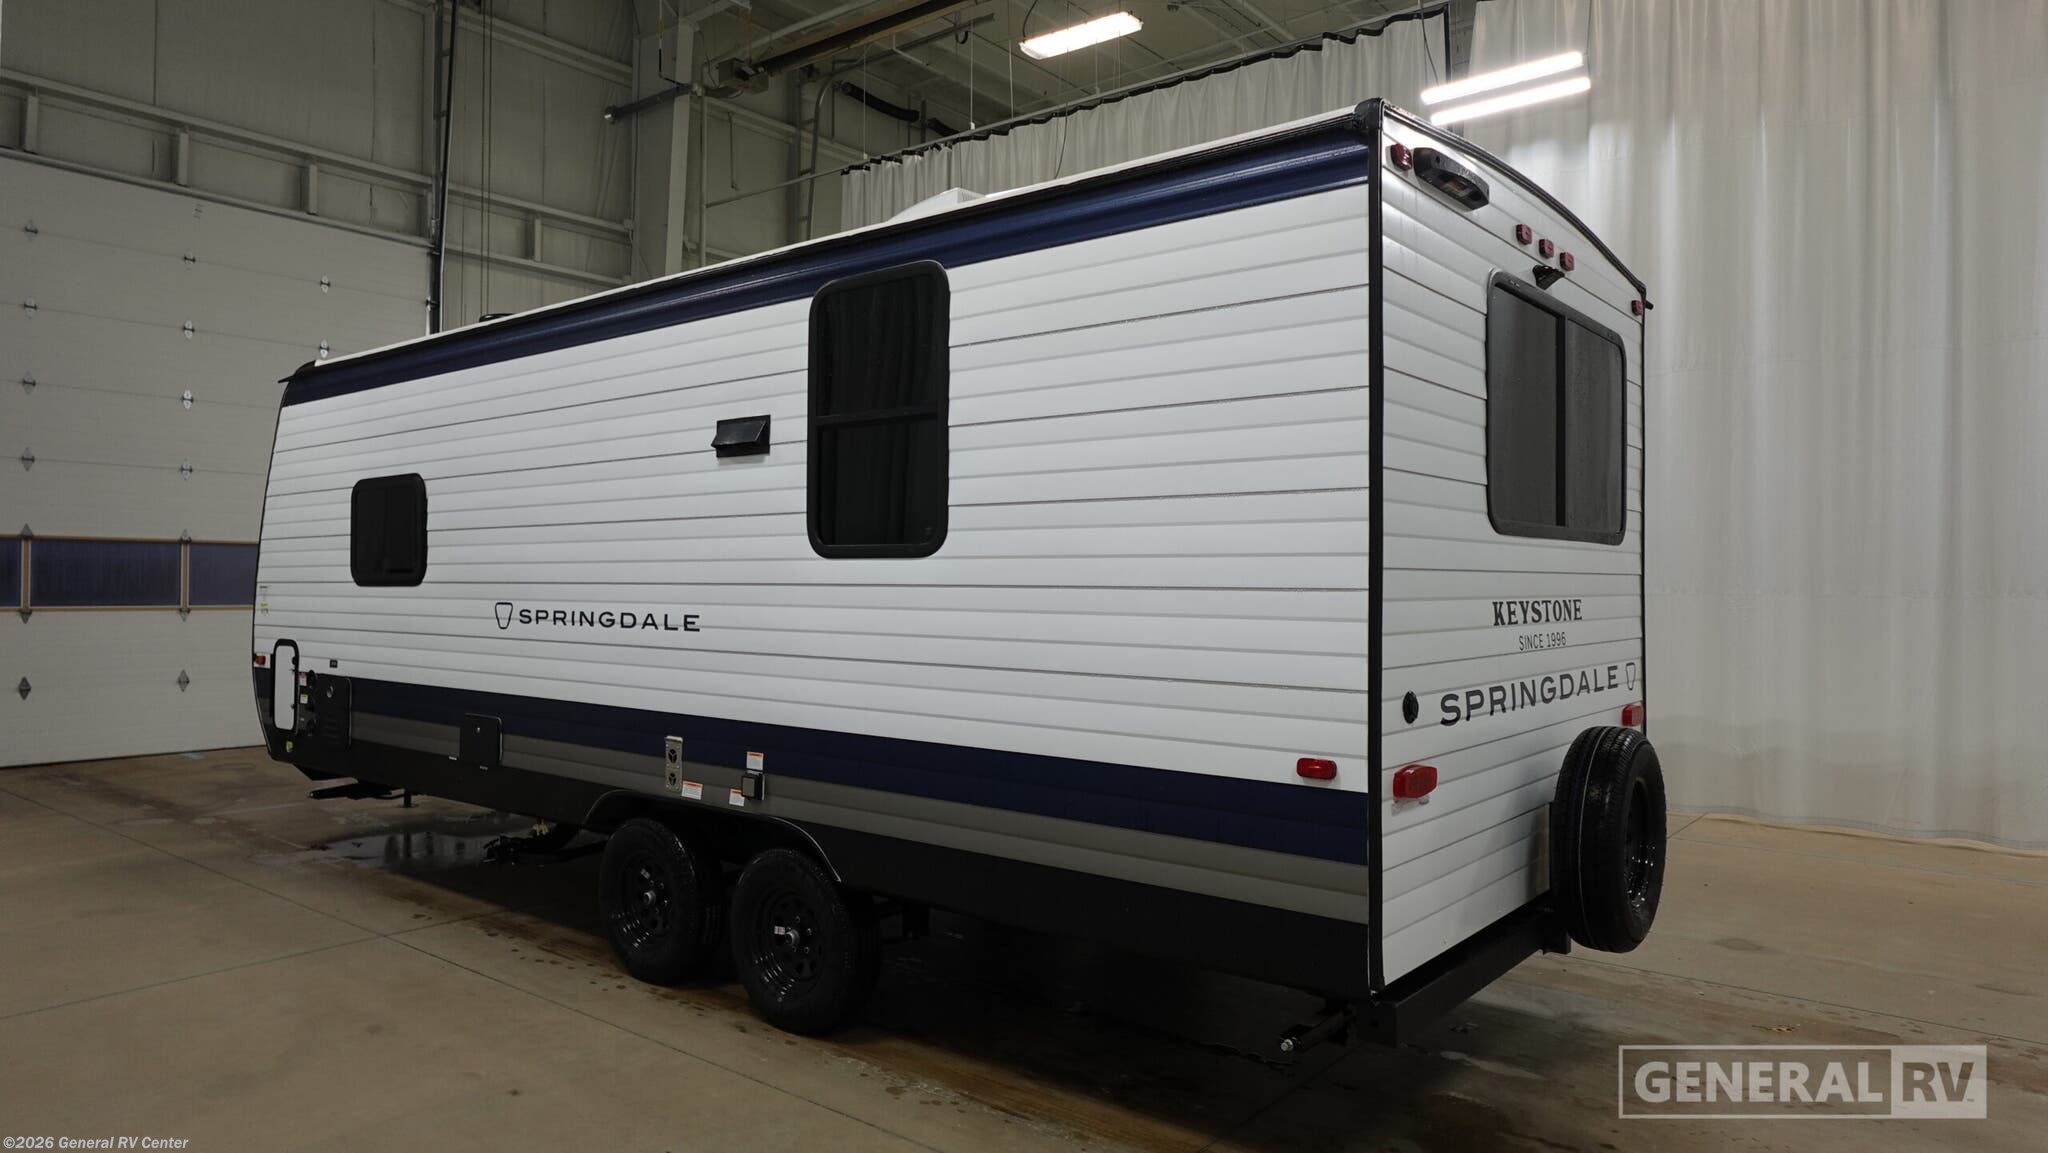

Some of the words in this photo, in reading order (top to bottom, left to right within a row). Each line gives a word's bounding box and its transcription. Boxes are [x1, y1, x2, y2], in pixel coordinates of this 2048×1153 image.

[518, 608, 701, 632] SPRINGDALE
[1491, 599, 1583, 627] KEYSTONE
[1518, 633, 1544, 651] SINCE
[1546, 631, 1567, 648] 1996
[1439, 665, 1620, 727] SPRINGDALE
